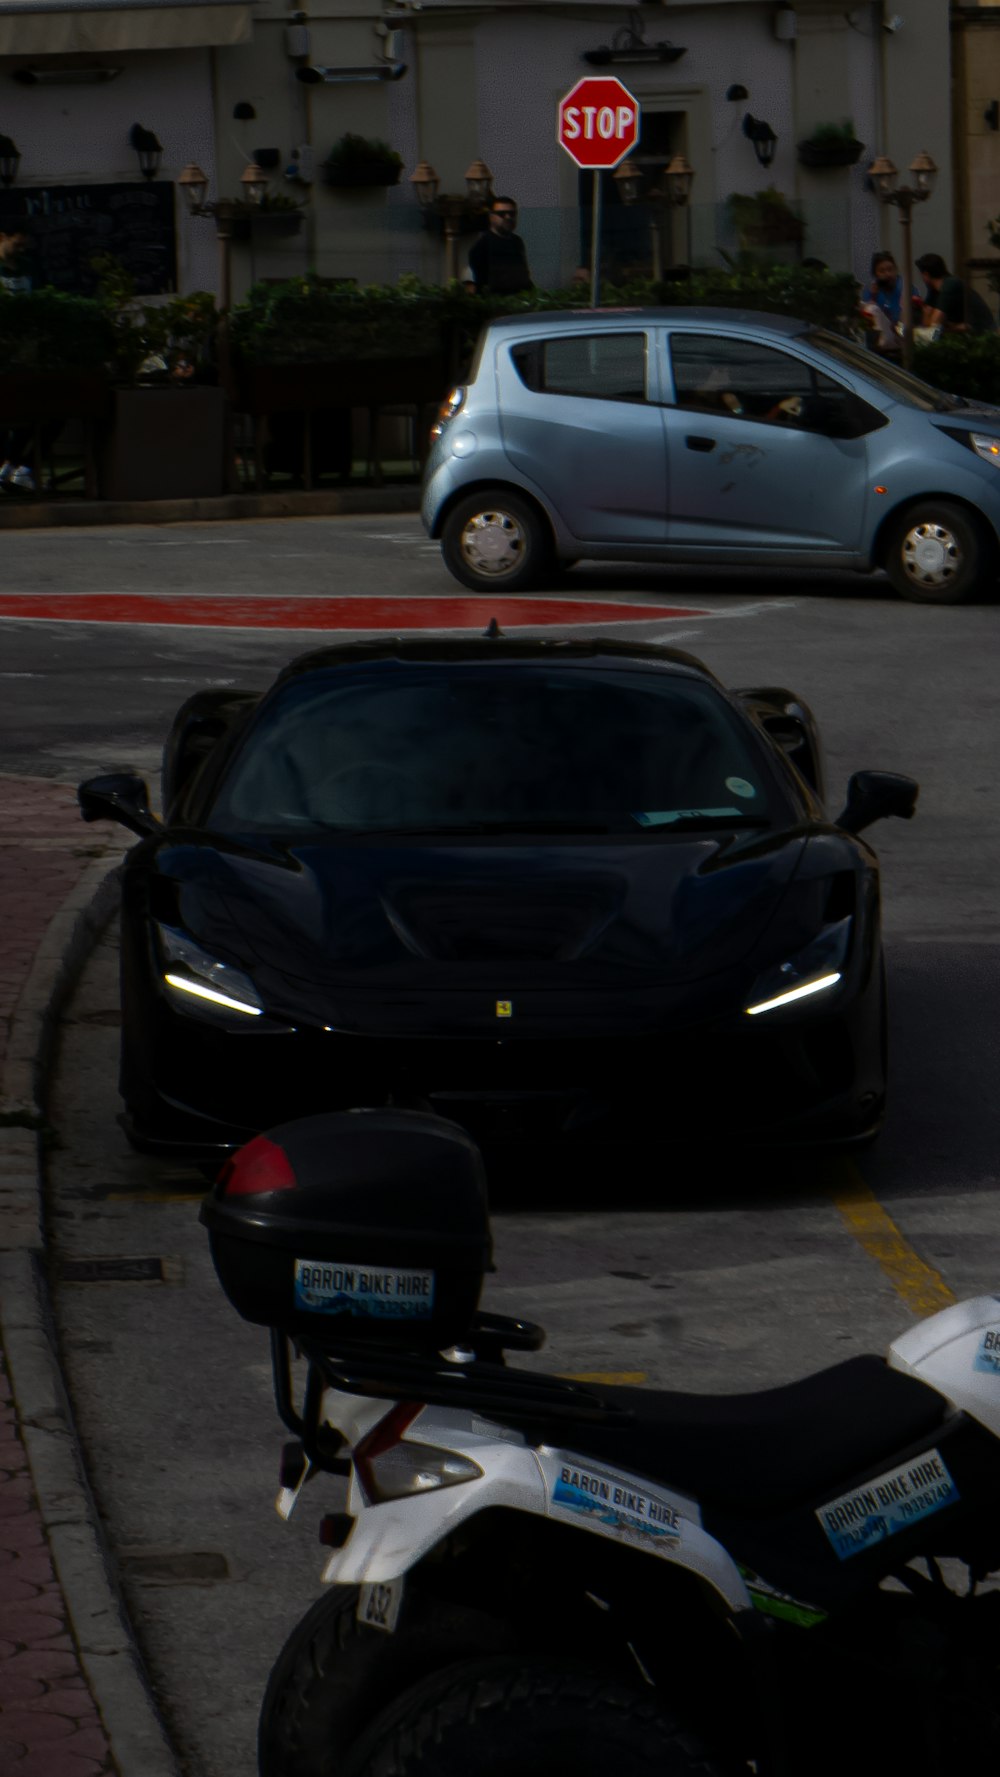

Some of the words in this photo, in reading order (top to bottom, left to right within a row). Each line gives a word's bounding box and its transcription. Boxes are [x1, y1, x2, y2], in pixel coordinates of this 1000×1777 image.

[563, 105, 634, 139] STOP
[302, 1267, 354, 1291] BARON
[359, 1273, 391, 1295] BIKE
[397, 1275, 430, 1296] HIRE
[561, 1467, 610, 1500] BARON
[613, 1487, 646, 1514] BIKE
[649, 1501, 680, 1530] HIRE
[825, 1491, 878, 1532] BARON
[876, 1475, 910, 1506] BIKE
[908, 1458, 945, 1489] HIRE
